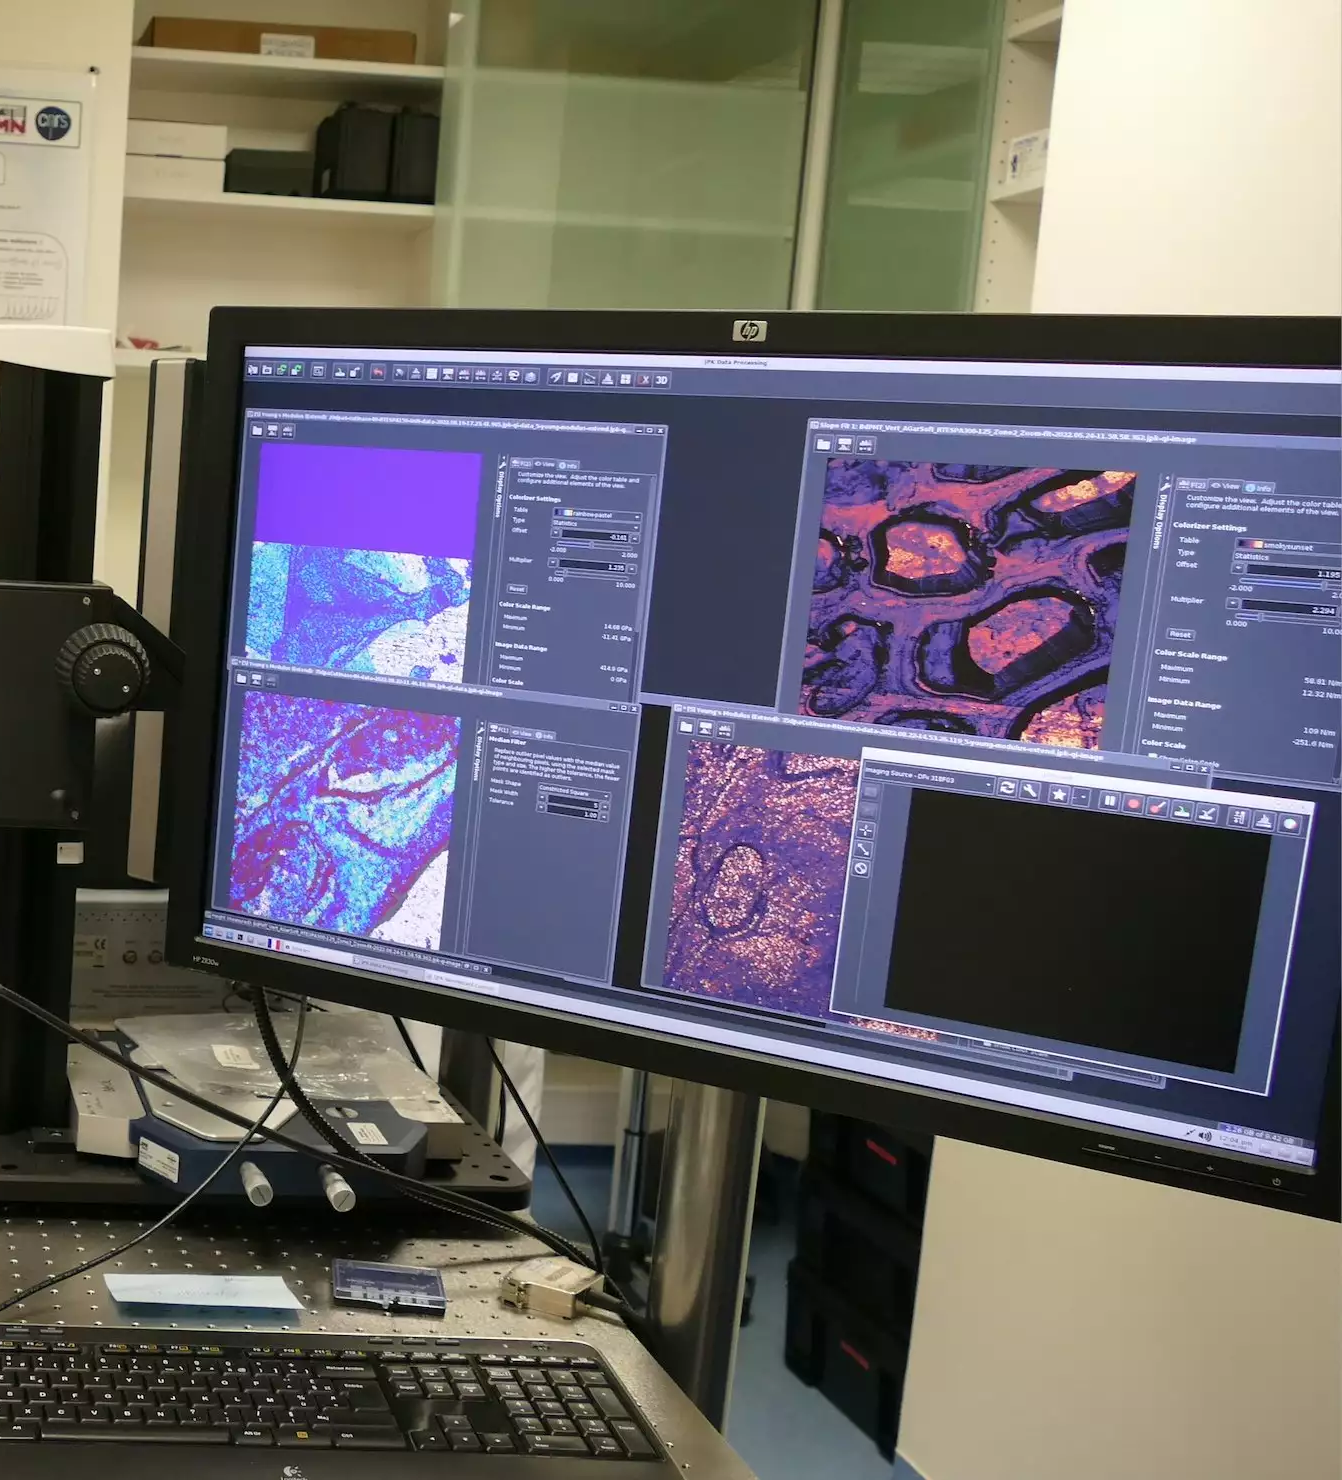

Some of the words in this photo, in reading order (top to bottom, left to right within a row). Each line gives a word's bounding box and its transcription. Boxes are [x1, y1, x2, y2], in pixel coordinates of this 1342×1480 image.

[741, 320, 759, 341] hp
[655, 376, 668, 384] 3D
[509, 494, 535, 502] Colorizer
[1187, 494, 1223, 503] Customize
[1261, 498, 1285, 506] Adjust
[1156, 494, 1167, 520] Display
[1186, 502, 1220, 510] configure
[1222, 504, 1258, 512] additional
[1260, 506, 1294, 514] elements
[553, 519, 577, 527] Statistics
[1173, 521, 1210, 530] Colorizer
[1211, 524, 1247, 533] Settings
[1153, 522, 1163, 549] Options
[1179, 536, 1200, 544] Table
[1178, 548, 1196, 556] Type
[509, 556, 533, 564] Multiplier
[1235, 553, 1269, 561] Statistics
[509, 585, 525, 593] Reset
[1229, 584, 1253, 592] -2.000
[1171, 596, 1204, 604] Multiplier
[532, 604, 551, 612] Range
[1170, 630, 1192, 639] Reset
[495, 641, 512, 649] Image
[1154, 649, 1176, 657] Color
[1177, 651, 1200, 659] Scale
[1201, 653, 1228, 662] Range
[1160, 663, 1194, 673] Maximum
[1159, 675, 1191, 684] Minimum
[1147, 696, 1172, 706] Image
[1173, 699, 1194, 707] Data
[1195, 701, 1222, 710] Range
[1154, 711, 1187, 721] Maximum
[1152, 723, 1184, 733] Minimum
[1303, 727, 1319, 735] 109
[1320, 728, 1336, 737] N/m
[489, 736, 510, 744] Median
[511, 738, 526, 746] Filter
[1142, 739, 1163, 747] Color
[1164, 741, 1186, 750] Scale
[1318, 741, 1334, 749] N/m
[891, 770, 913, 779] Source
[504, 779, 521, 787] Shape
[570, 789, 589, 797] Square
[489, 797, 514, 806] Tolerance
